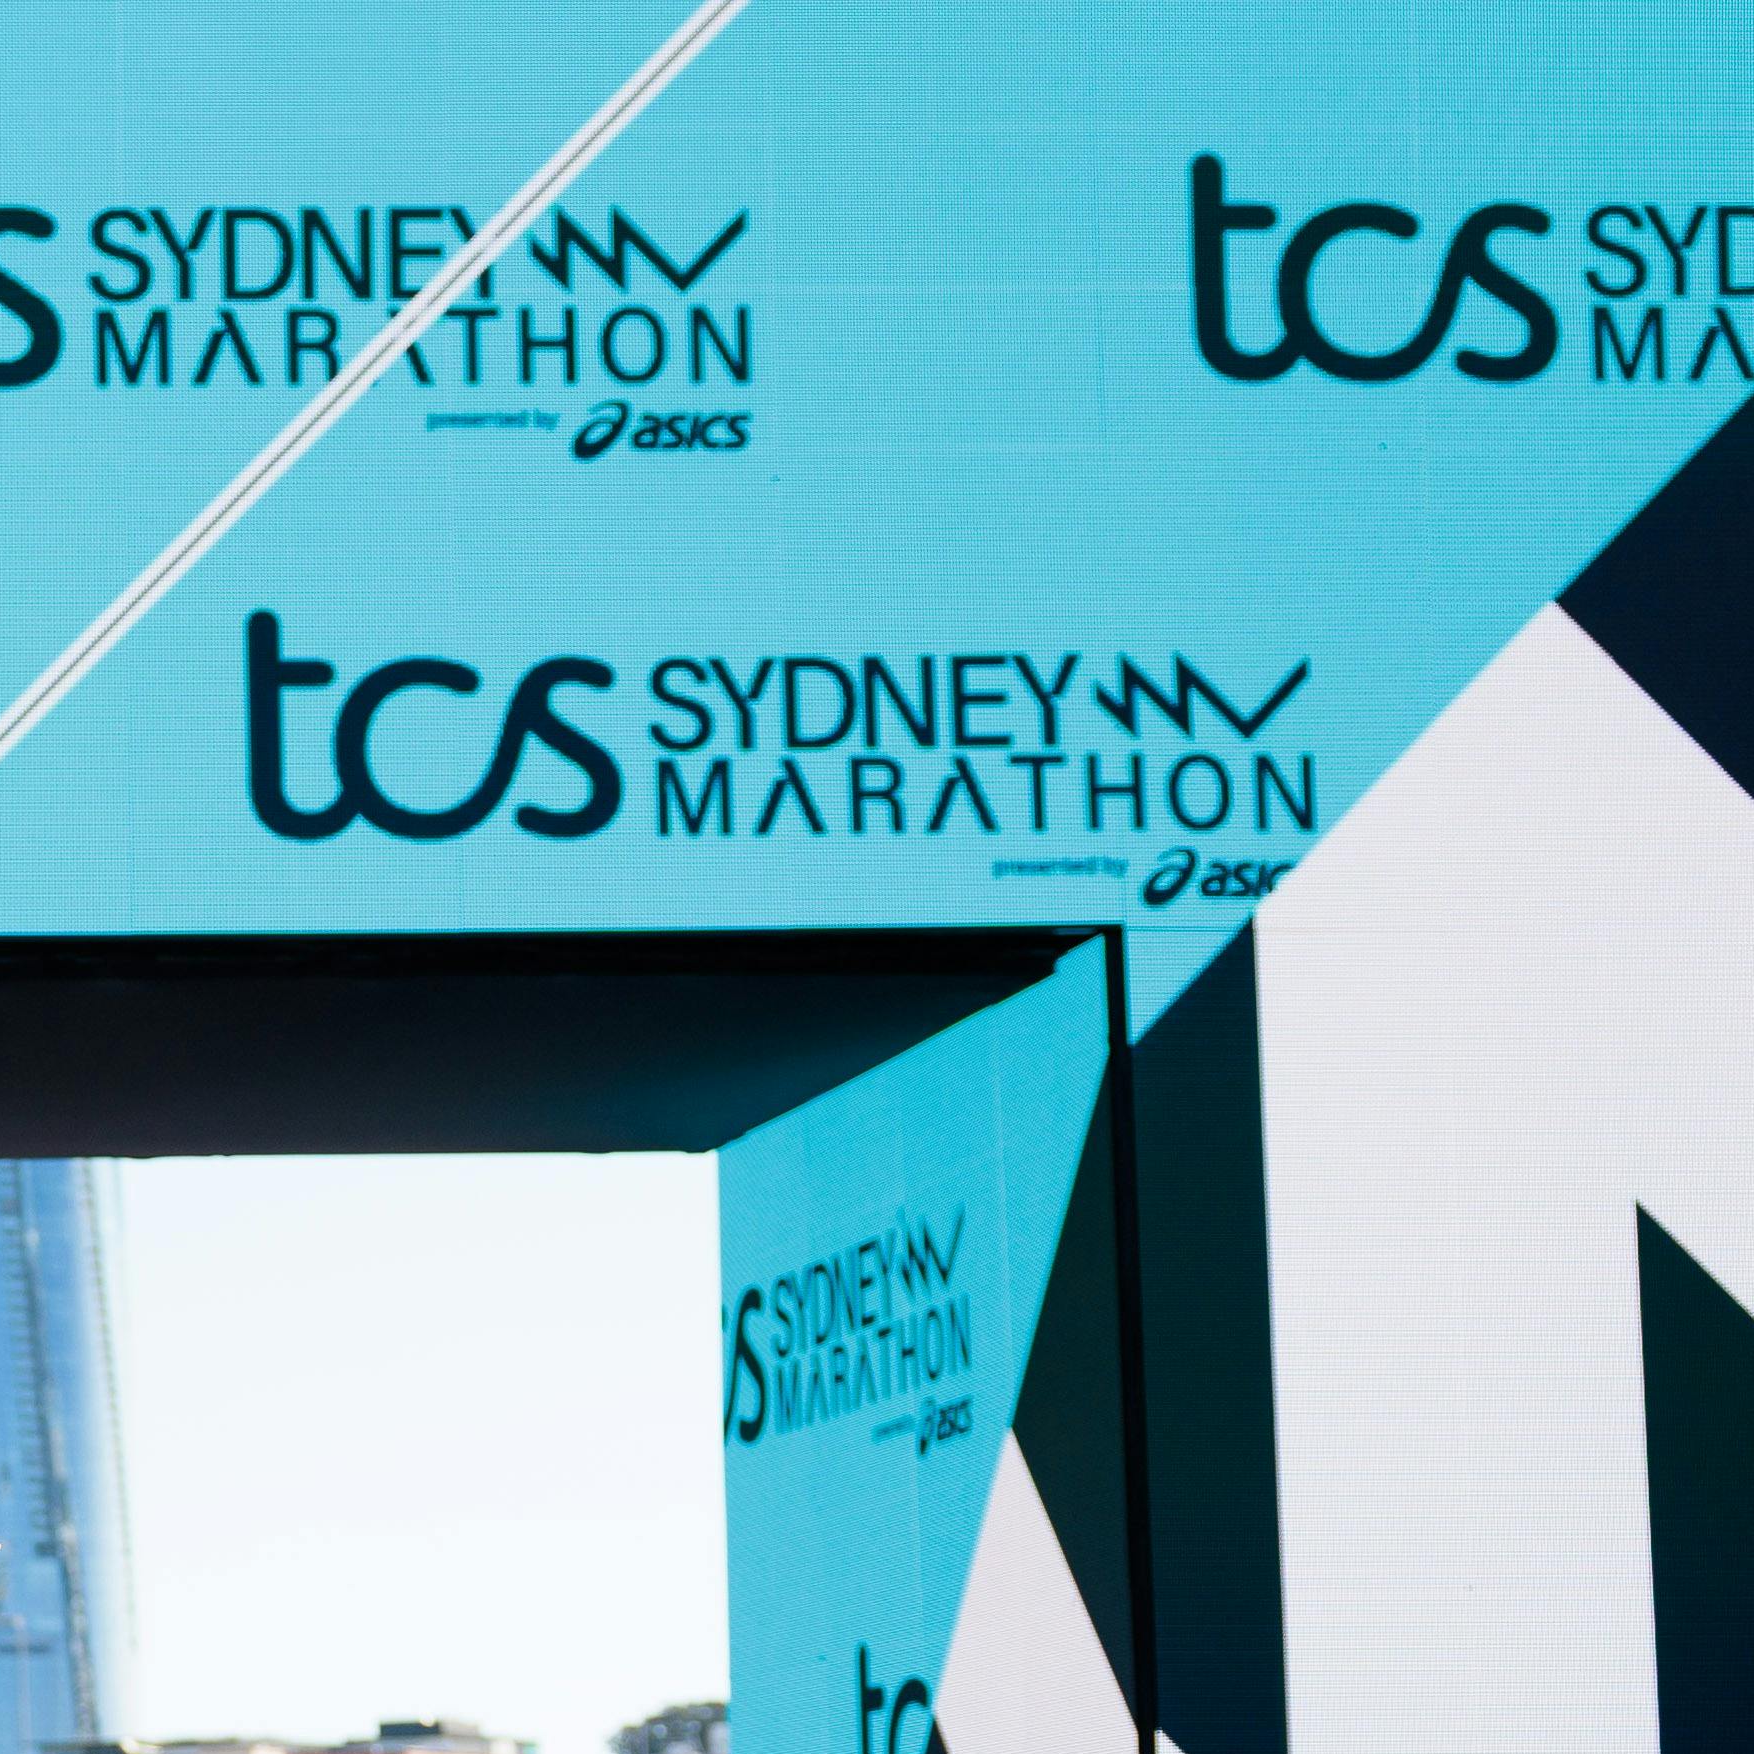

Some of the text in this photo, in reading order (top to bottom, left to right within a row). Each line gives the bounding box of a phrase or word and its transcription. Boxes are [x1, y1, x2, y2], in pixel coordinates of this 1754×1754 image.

[1188, 154, 1559, 384] tcs
[1591, 304, 1754, 382] MA
[631, 413, 751, 452] asics
[246, 610, 623, 842] tcs
[647, 653, 1080, 748] SYDNEY
[655, 750, 1315, 836] MARATHON
[773, 1230, 893, 1358] SYDNEY
[723, 1287, 766, 1444] s
[774, 1293, 972, 1433] MARATHON
